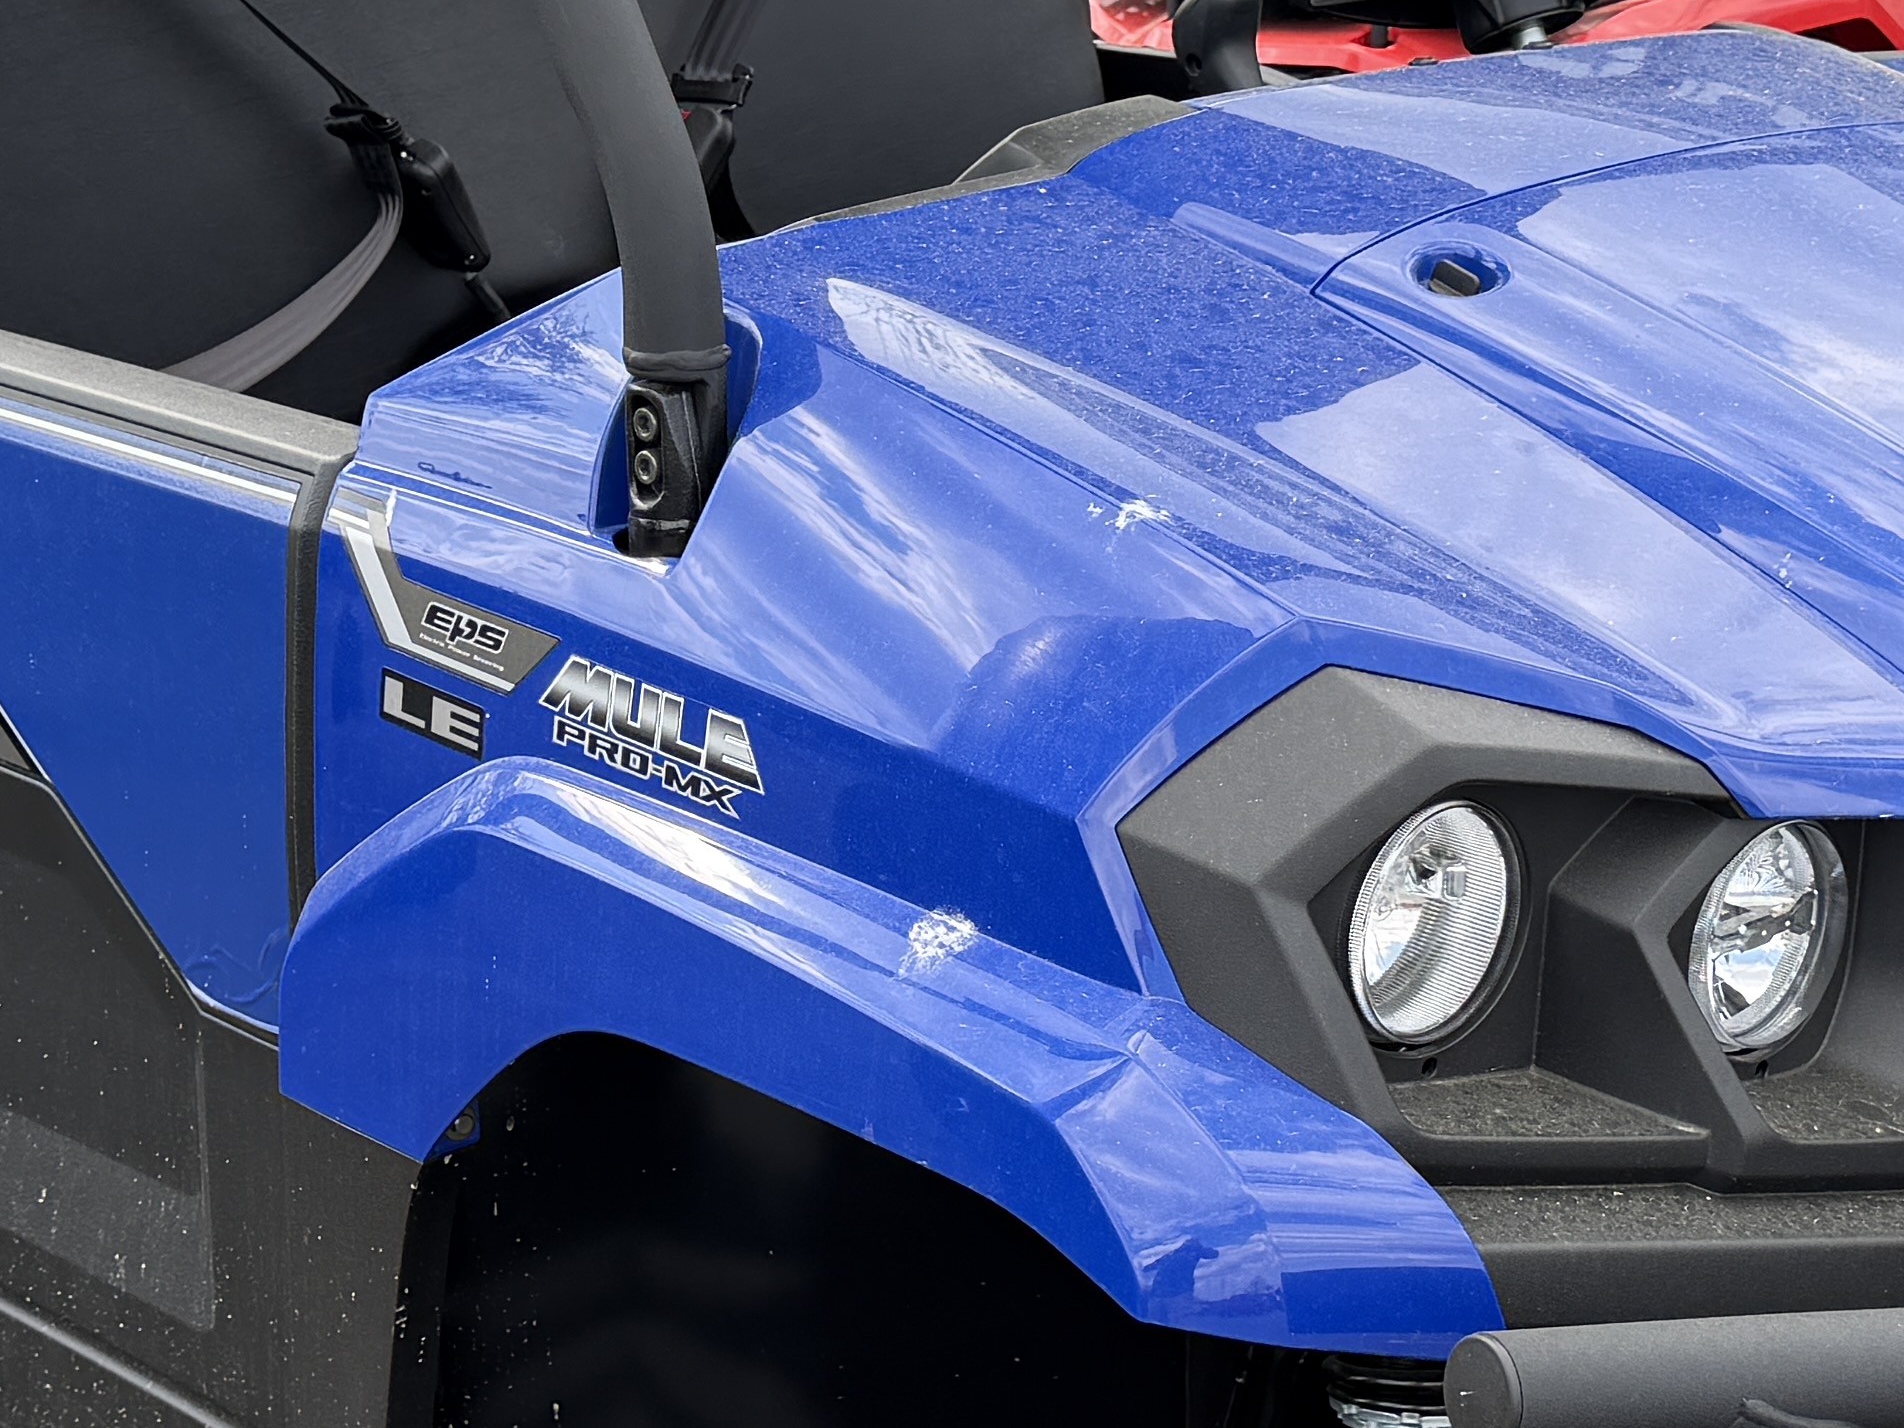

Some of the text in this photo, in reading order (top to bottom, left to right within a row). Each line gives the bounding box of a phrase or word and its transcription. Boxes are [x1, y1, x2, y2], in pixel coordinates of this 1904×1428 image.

[383, 673, 481, 753] LE
[538, 653, 766, 797] MULE
[551, 716, 742, 821] PRO-MX
